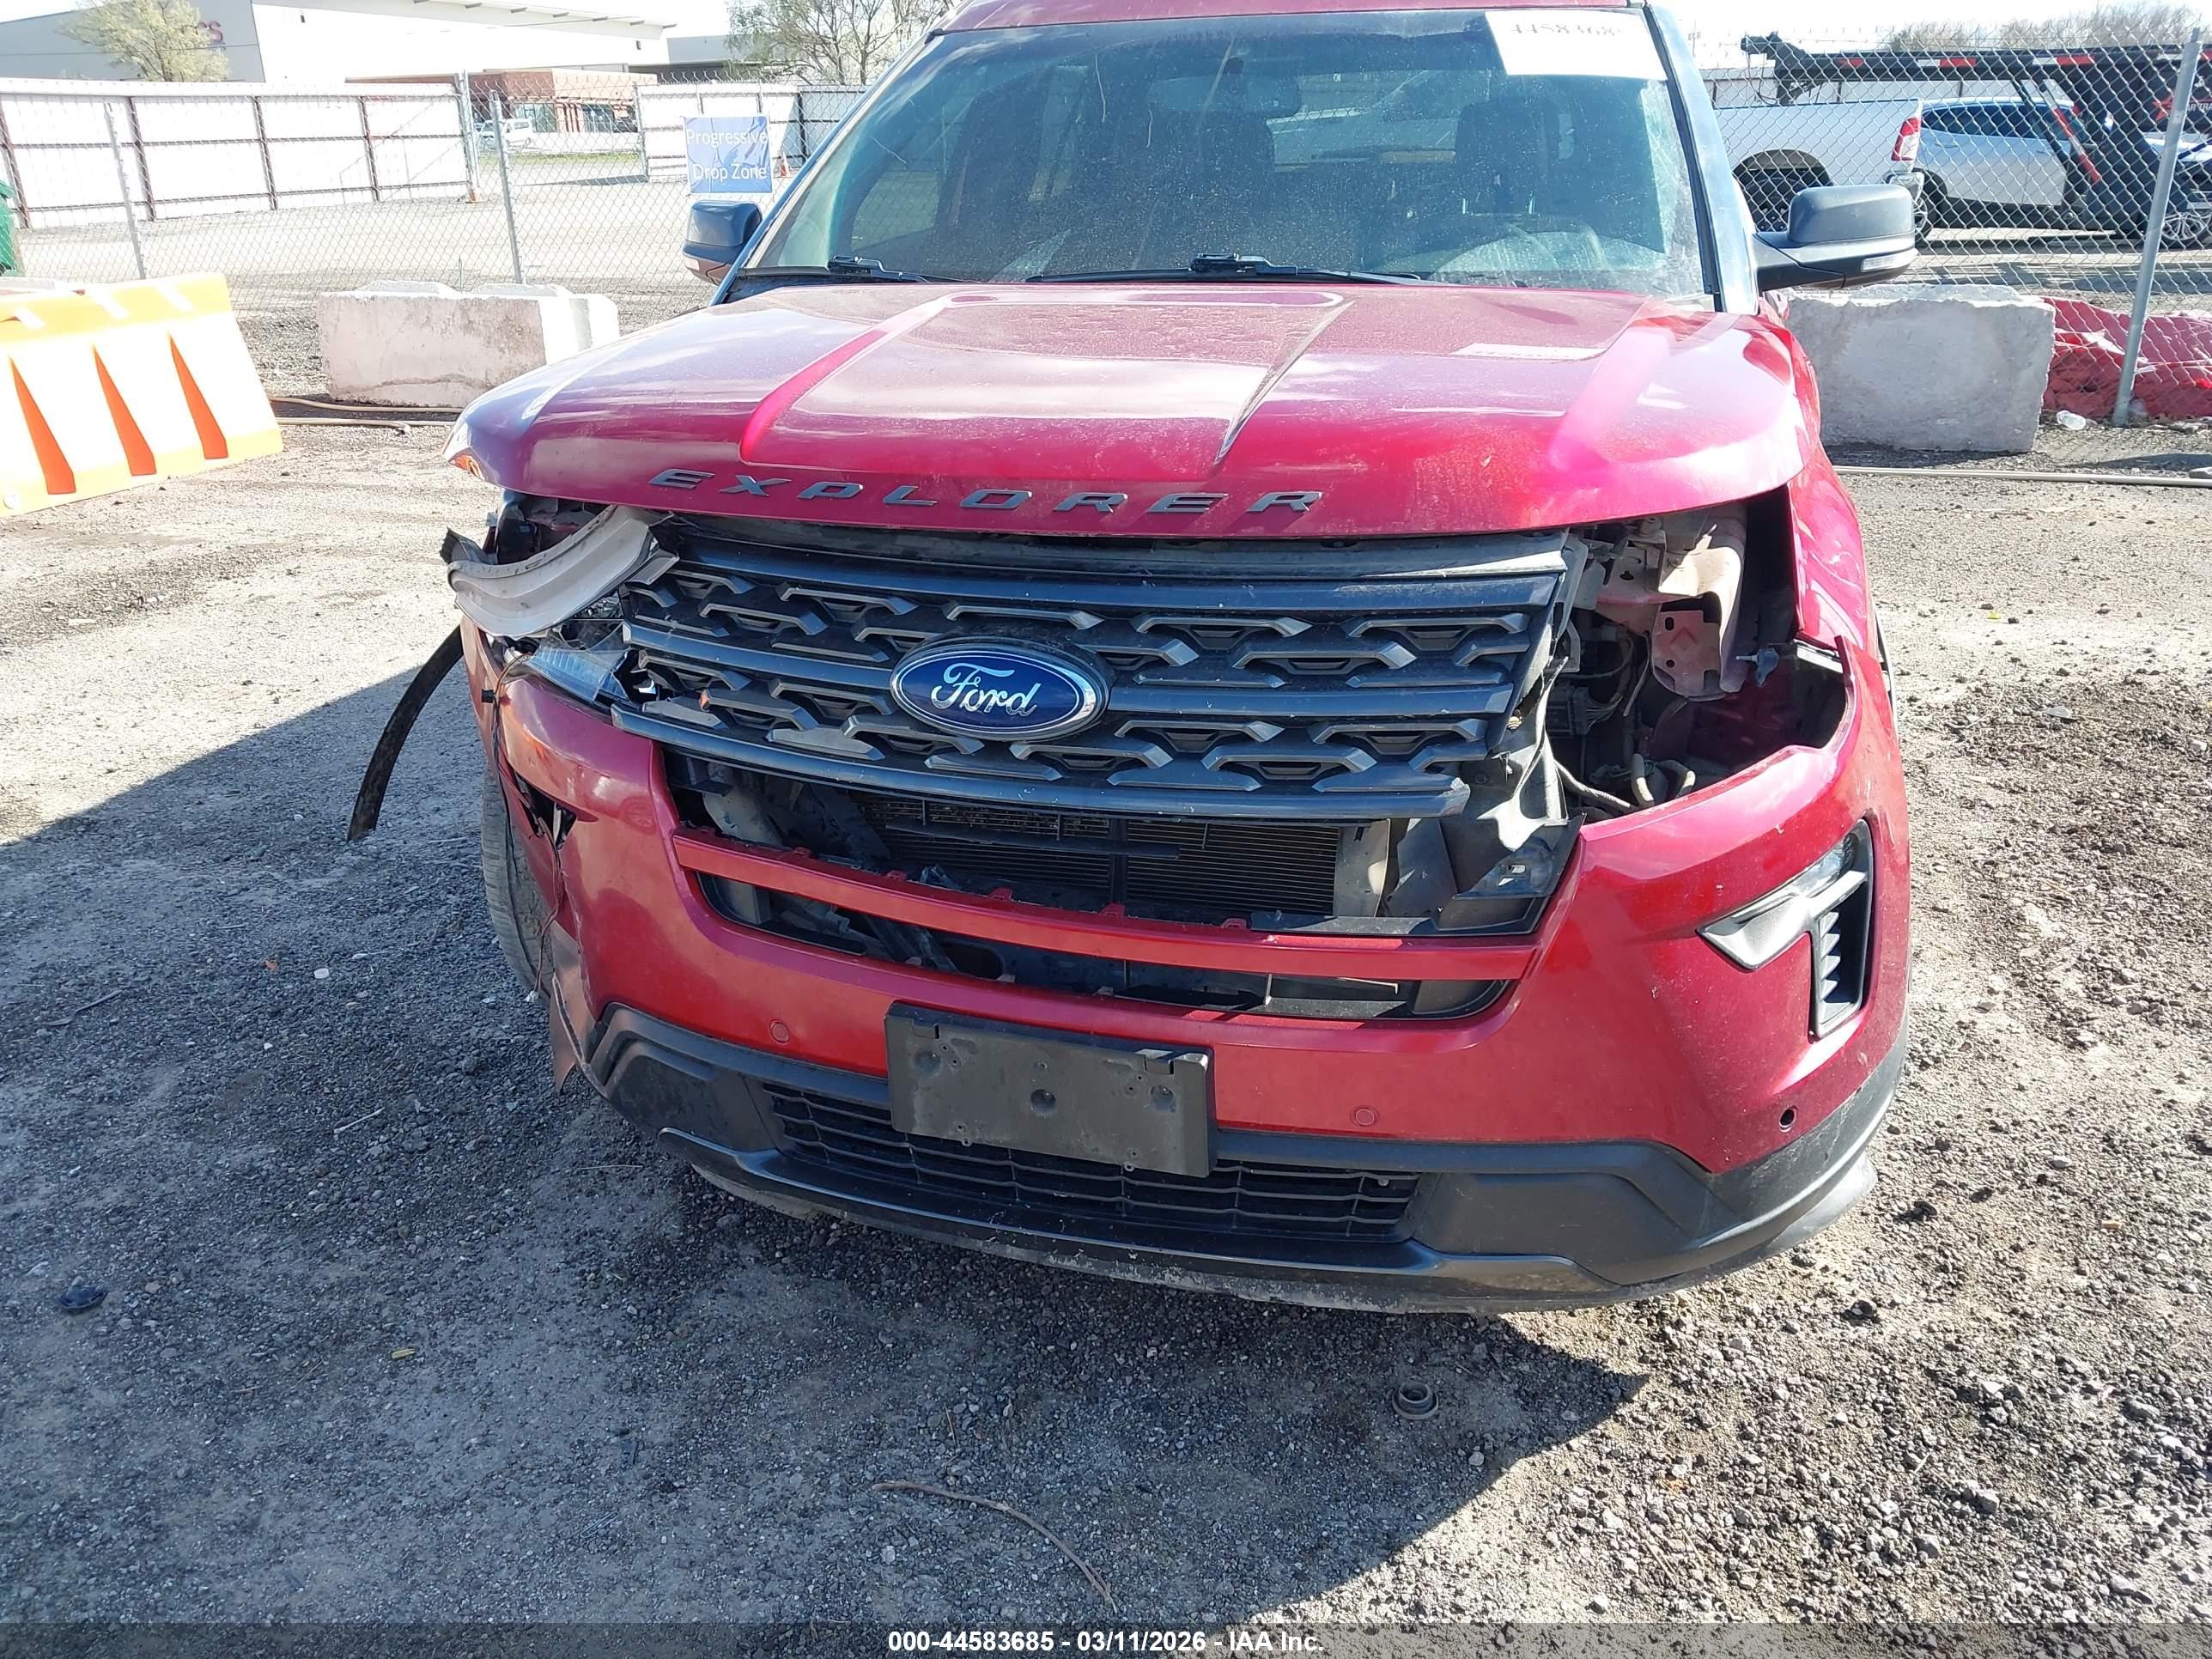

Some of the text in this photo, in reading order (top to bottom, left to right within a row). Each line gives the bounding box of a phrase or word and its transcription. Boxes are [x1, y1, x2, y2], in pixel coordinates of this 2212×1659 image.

[686, 129, 768, 148] Progressive
[692, 163, 767, 182] Drop Zone
[648, 468, 1323, 514] EXPLORER
[931, 662, 1042, 717] Ford
